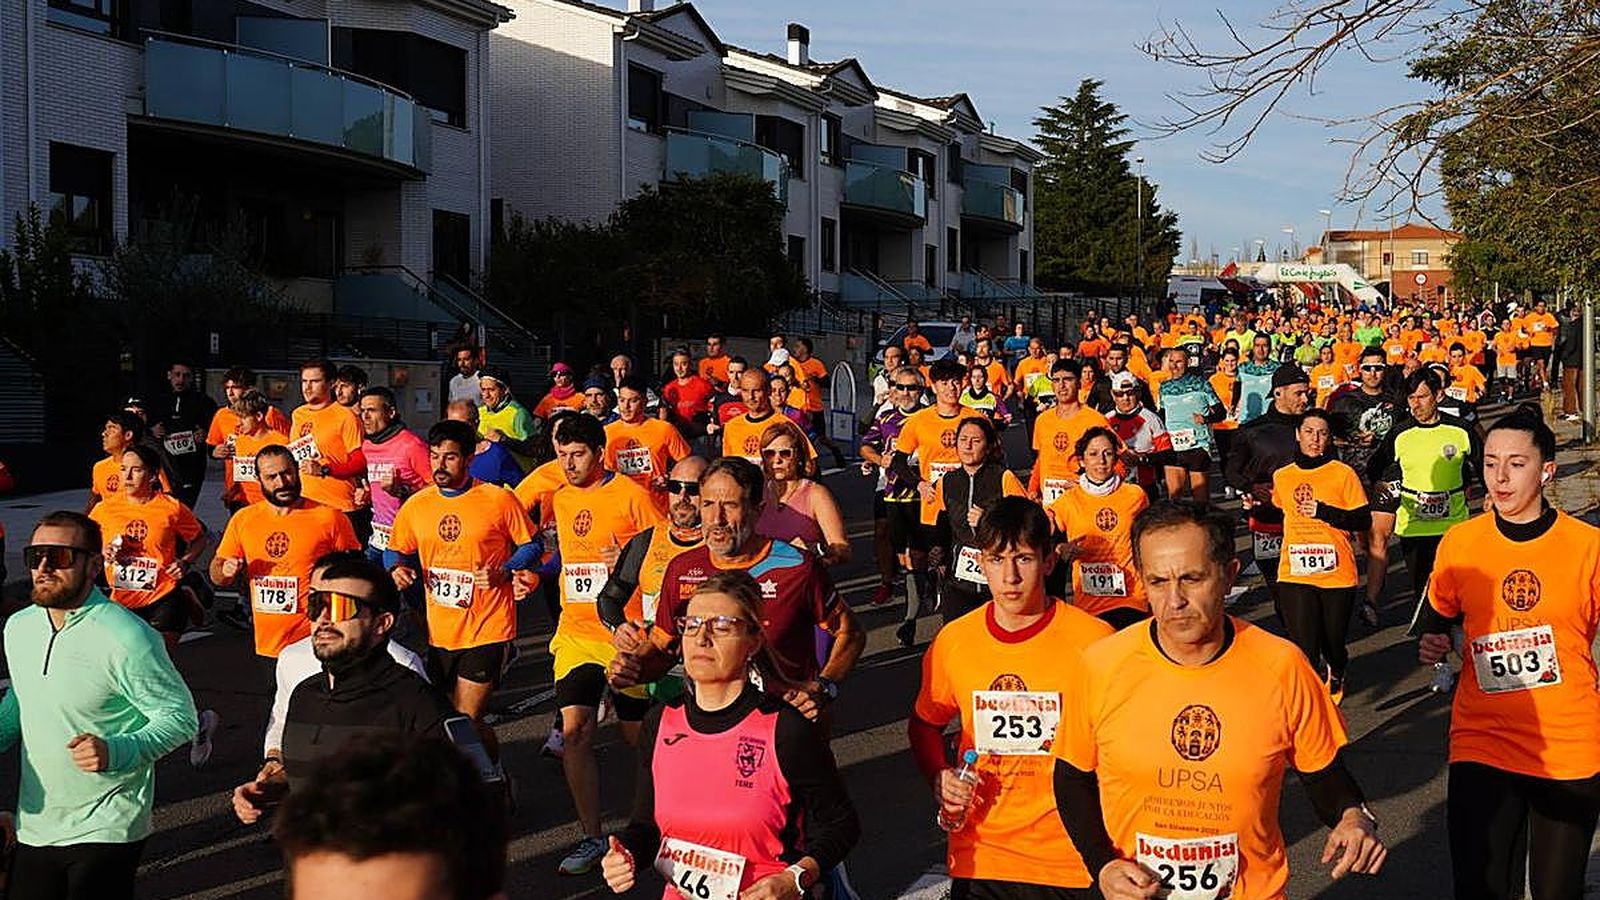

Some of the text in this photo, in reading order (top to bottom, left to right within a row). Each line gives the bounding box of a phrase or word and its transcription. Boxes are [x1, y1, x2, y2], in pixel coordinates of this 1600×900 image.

[1299, 556, 1325, 568] 181
[119, 569, 146, 582] 312
[575, 578, 592, 592] 89
[1089, 575, 1114, 588] 191
[260, 589, 286, 603] 178
[1471, 632, 1552, 654] bedunia
[1489, 650, 1541, 678] 503
[992, 714, 1043, 738] 253
[1157, 767, 1224, 794] UPSA
[1138, 837, 1236, 862] bedunia
[680, 870, 710, 899] 46
[1158, 863, 1218, 891] 256
